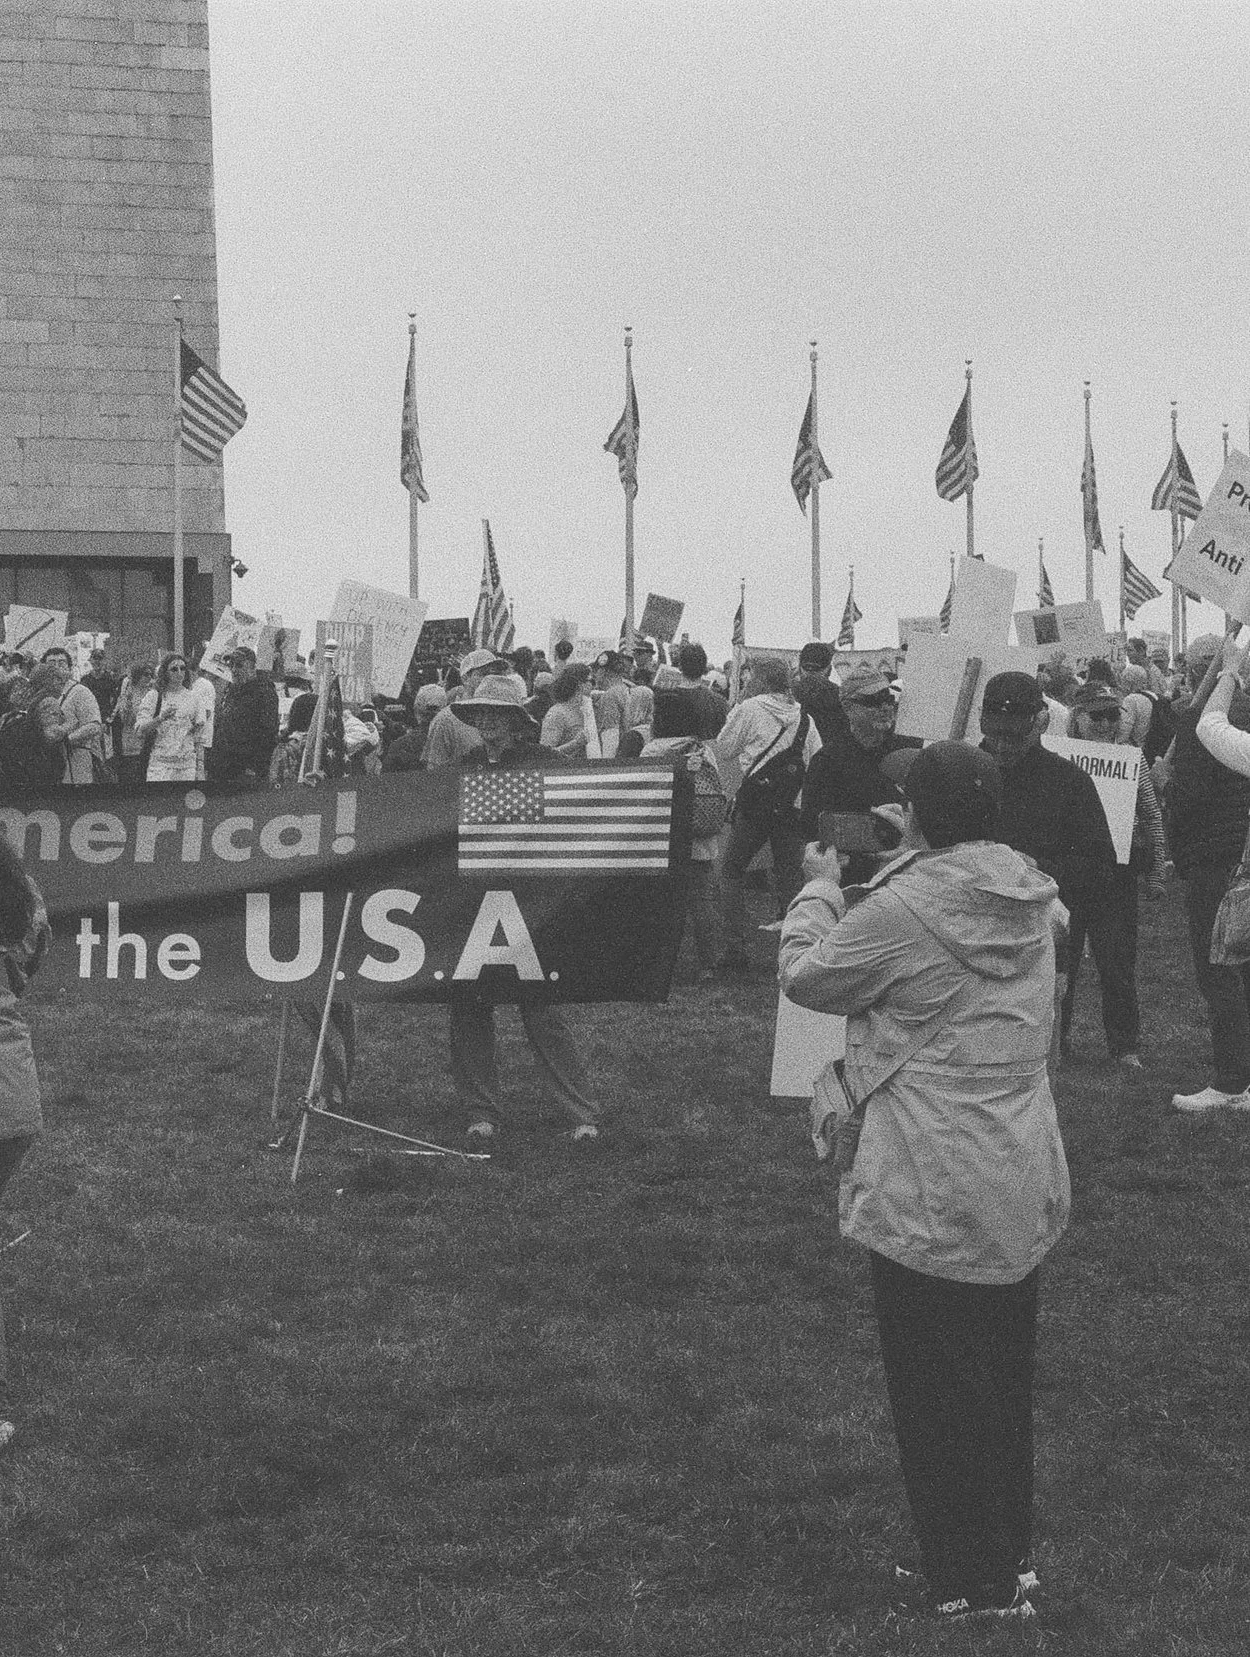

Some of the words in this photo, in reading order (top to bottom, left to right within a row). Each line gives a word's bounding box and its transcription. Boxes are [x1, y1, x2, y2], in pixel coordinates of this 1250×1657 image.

[1227, 480, 1250, 512] Pr
[1199, 540, 1245, 576] Anti
[76, 901, 202, 981] the
[244, 888, 560, 984] U.S.A.
[937, 1597, 970, 1613] HOKA
